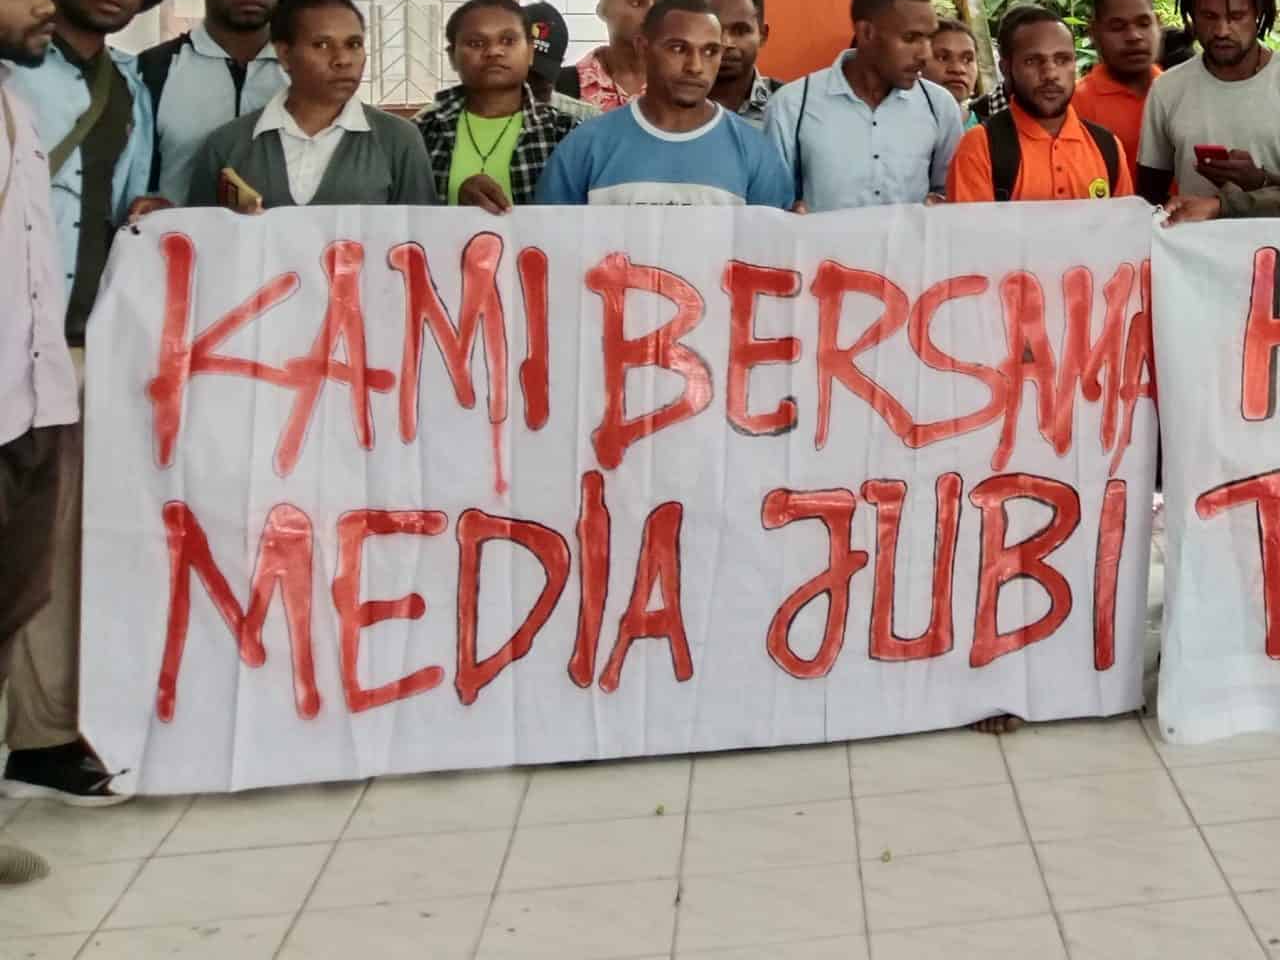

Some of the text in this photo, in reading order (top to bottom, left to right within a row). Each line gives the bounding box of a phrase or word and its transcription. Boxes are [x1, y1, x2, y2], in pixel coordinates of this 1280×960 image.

[145, 231, 549, 476] KAMI
[156, 470, 1128, 723] MEDIA JUBI
